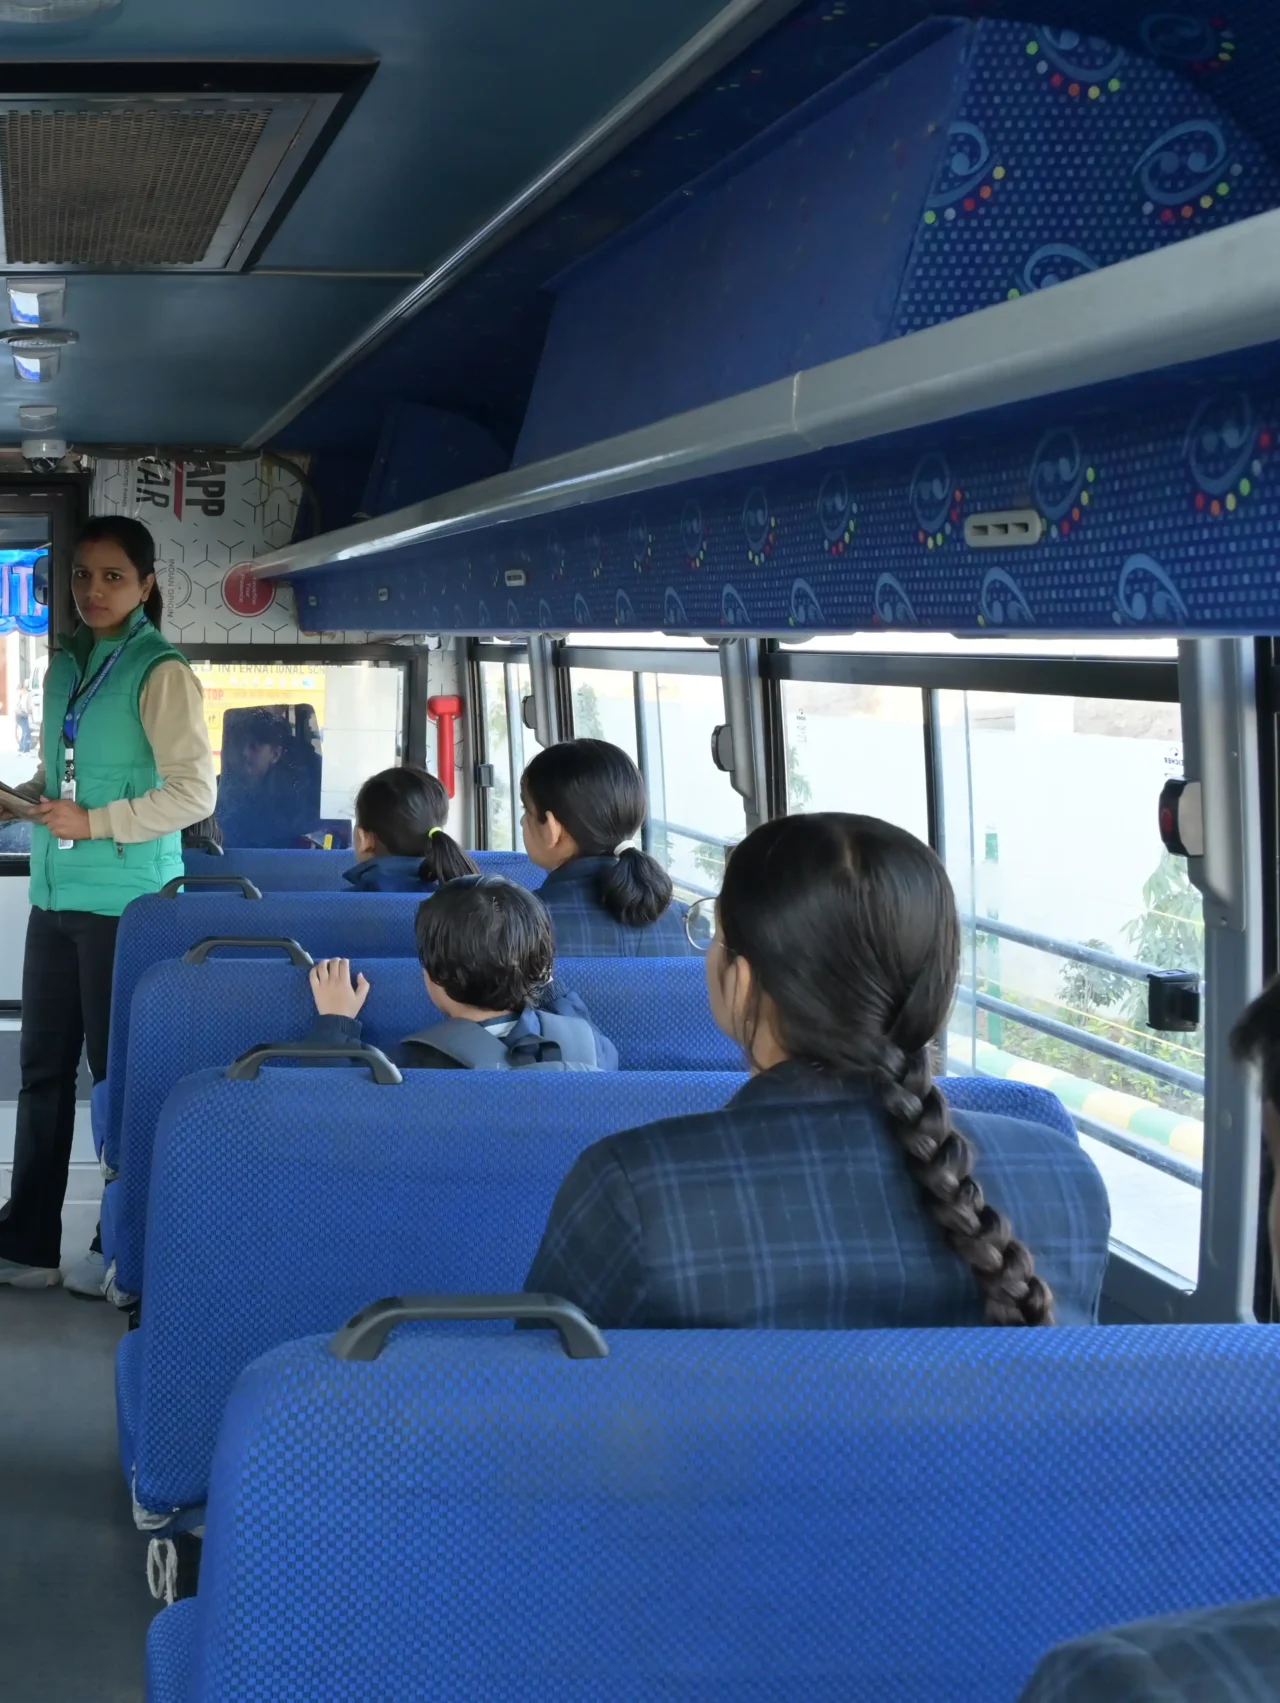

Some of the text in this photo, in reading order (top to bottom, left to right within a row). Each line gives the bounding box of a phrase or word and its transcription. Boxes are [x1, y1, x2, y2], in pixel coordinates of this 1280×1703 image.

[166, 558, 175, 618] INDIAN ORIGIN
[218, 664, 305, 675] INTERNATIONAL
[203, 689, 224, 701] TOP
